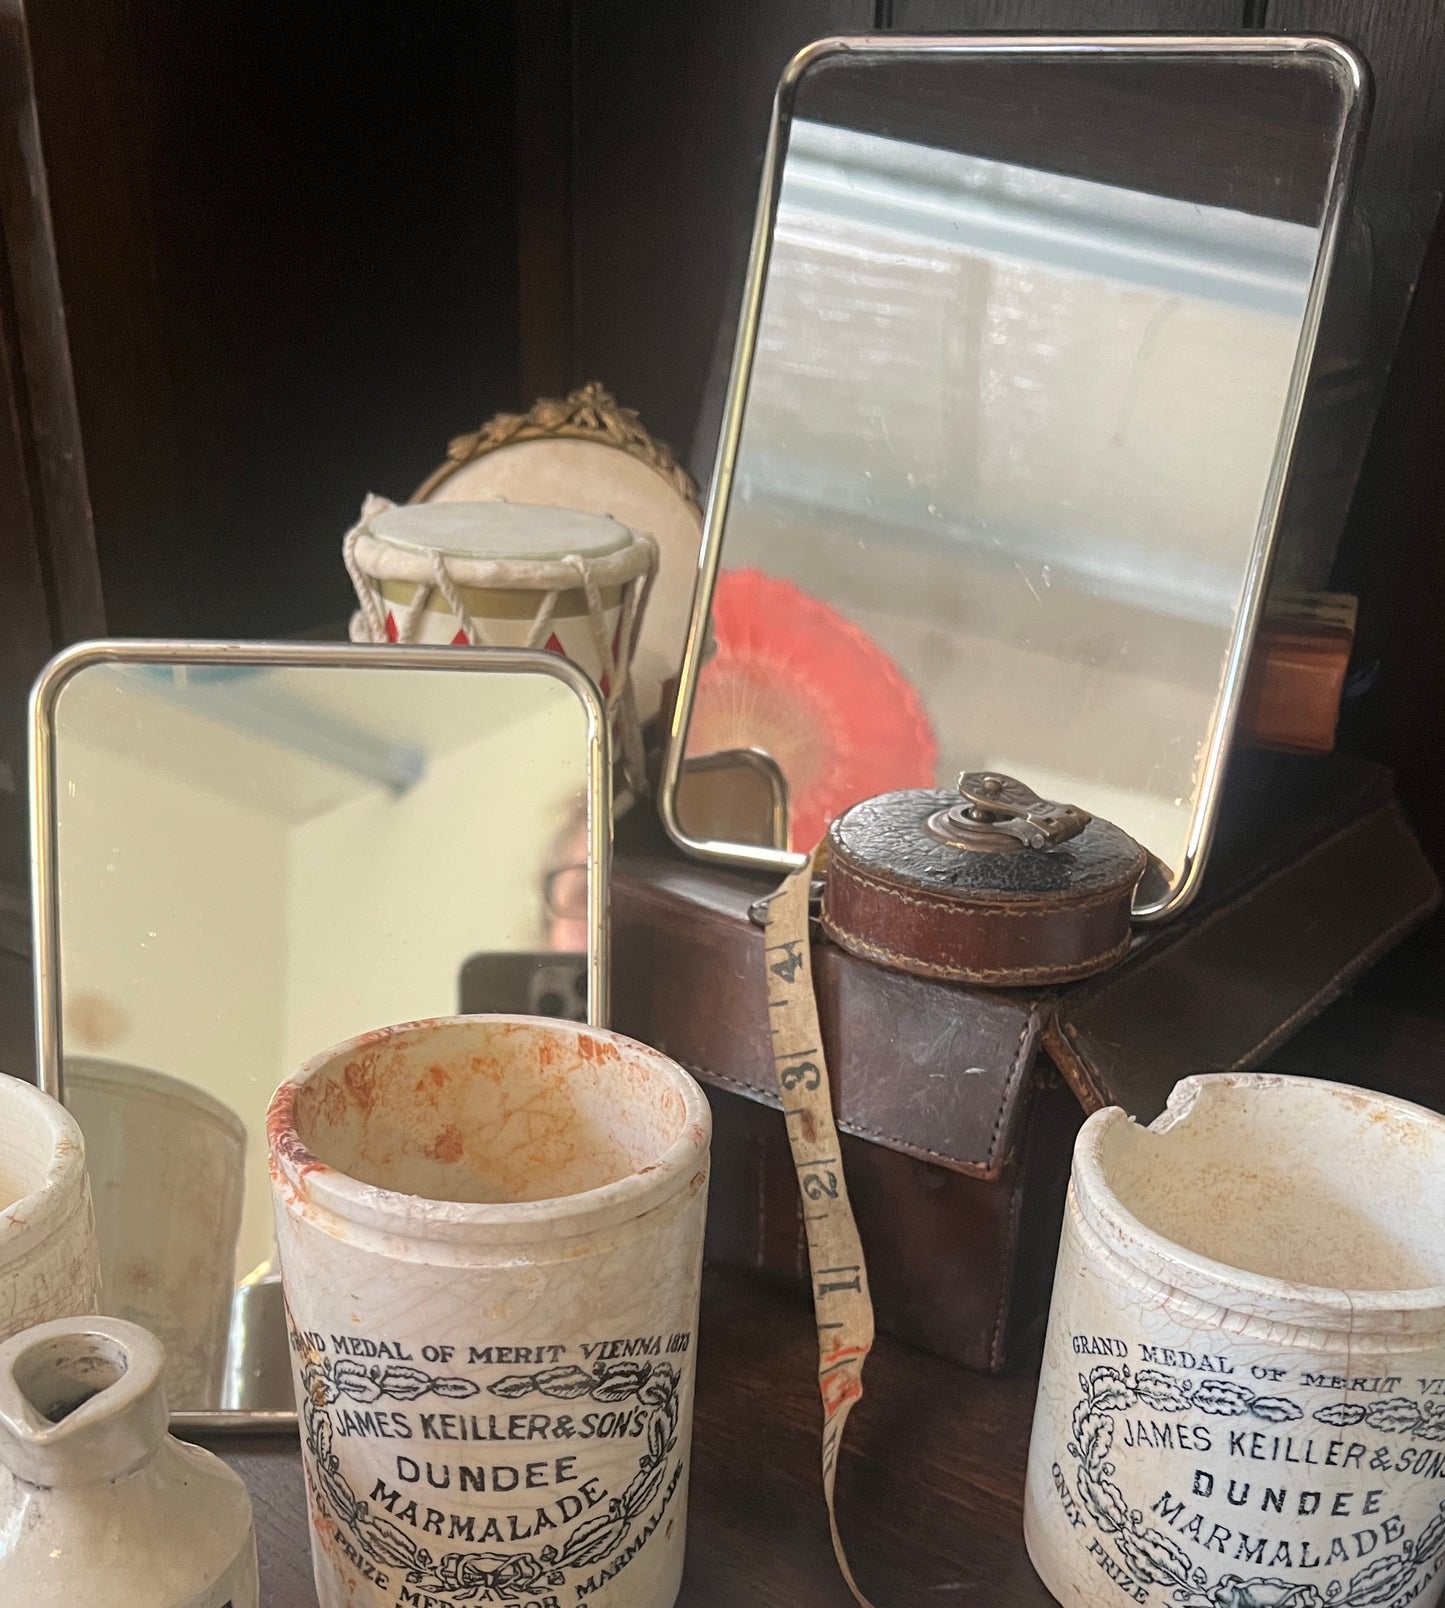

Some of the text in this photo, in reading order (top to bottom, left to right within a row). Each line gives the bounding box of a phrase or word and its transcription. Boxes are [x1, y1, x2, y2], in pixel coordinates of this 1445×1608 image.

[770, 944, 803, 984] 4
[782, 1062, 821, 1091] 3
[803, 1169, 838, 1200] 2
[817, 1275, 861, 1300] 1
[331, 1334, 413, 1361] MEDAL
[421, 1345, 455, 1363] OF
[467, 1345, 566, 1364] MERIT
[579, 1336, 662, 1360] VIENNA
[1072, 1335, 1445, 1395] GRAND MEDAL OF MERIT VI
[335, 1409, 412, 1440] JAMES
[1124, 1418, 1212, 1451] JAMES
[396, 1455, 577, 1492] DUNDEE
[1193, 1469, 1385, 1516] DUNDEE
[369, 1477, 609, 1543] MARMALADE
[1052, 1462, 1149, 1605] ONLY PRIZE
[1150, 1491, 1407, 1569] MARMALADE
[334, 1528, 389, 1590] PRIZE
